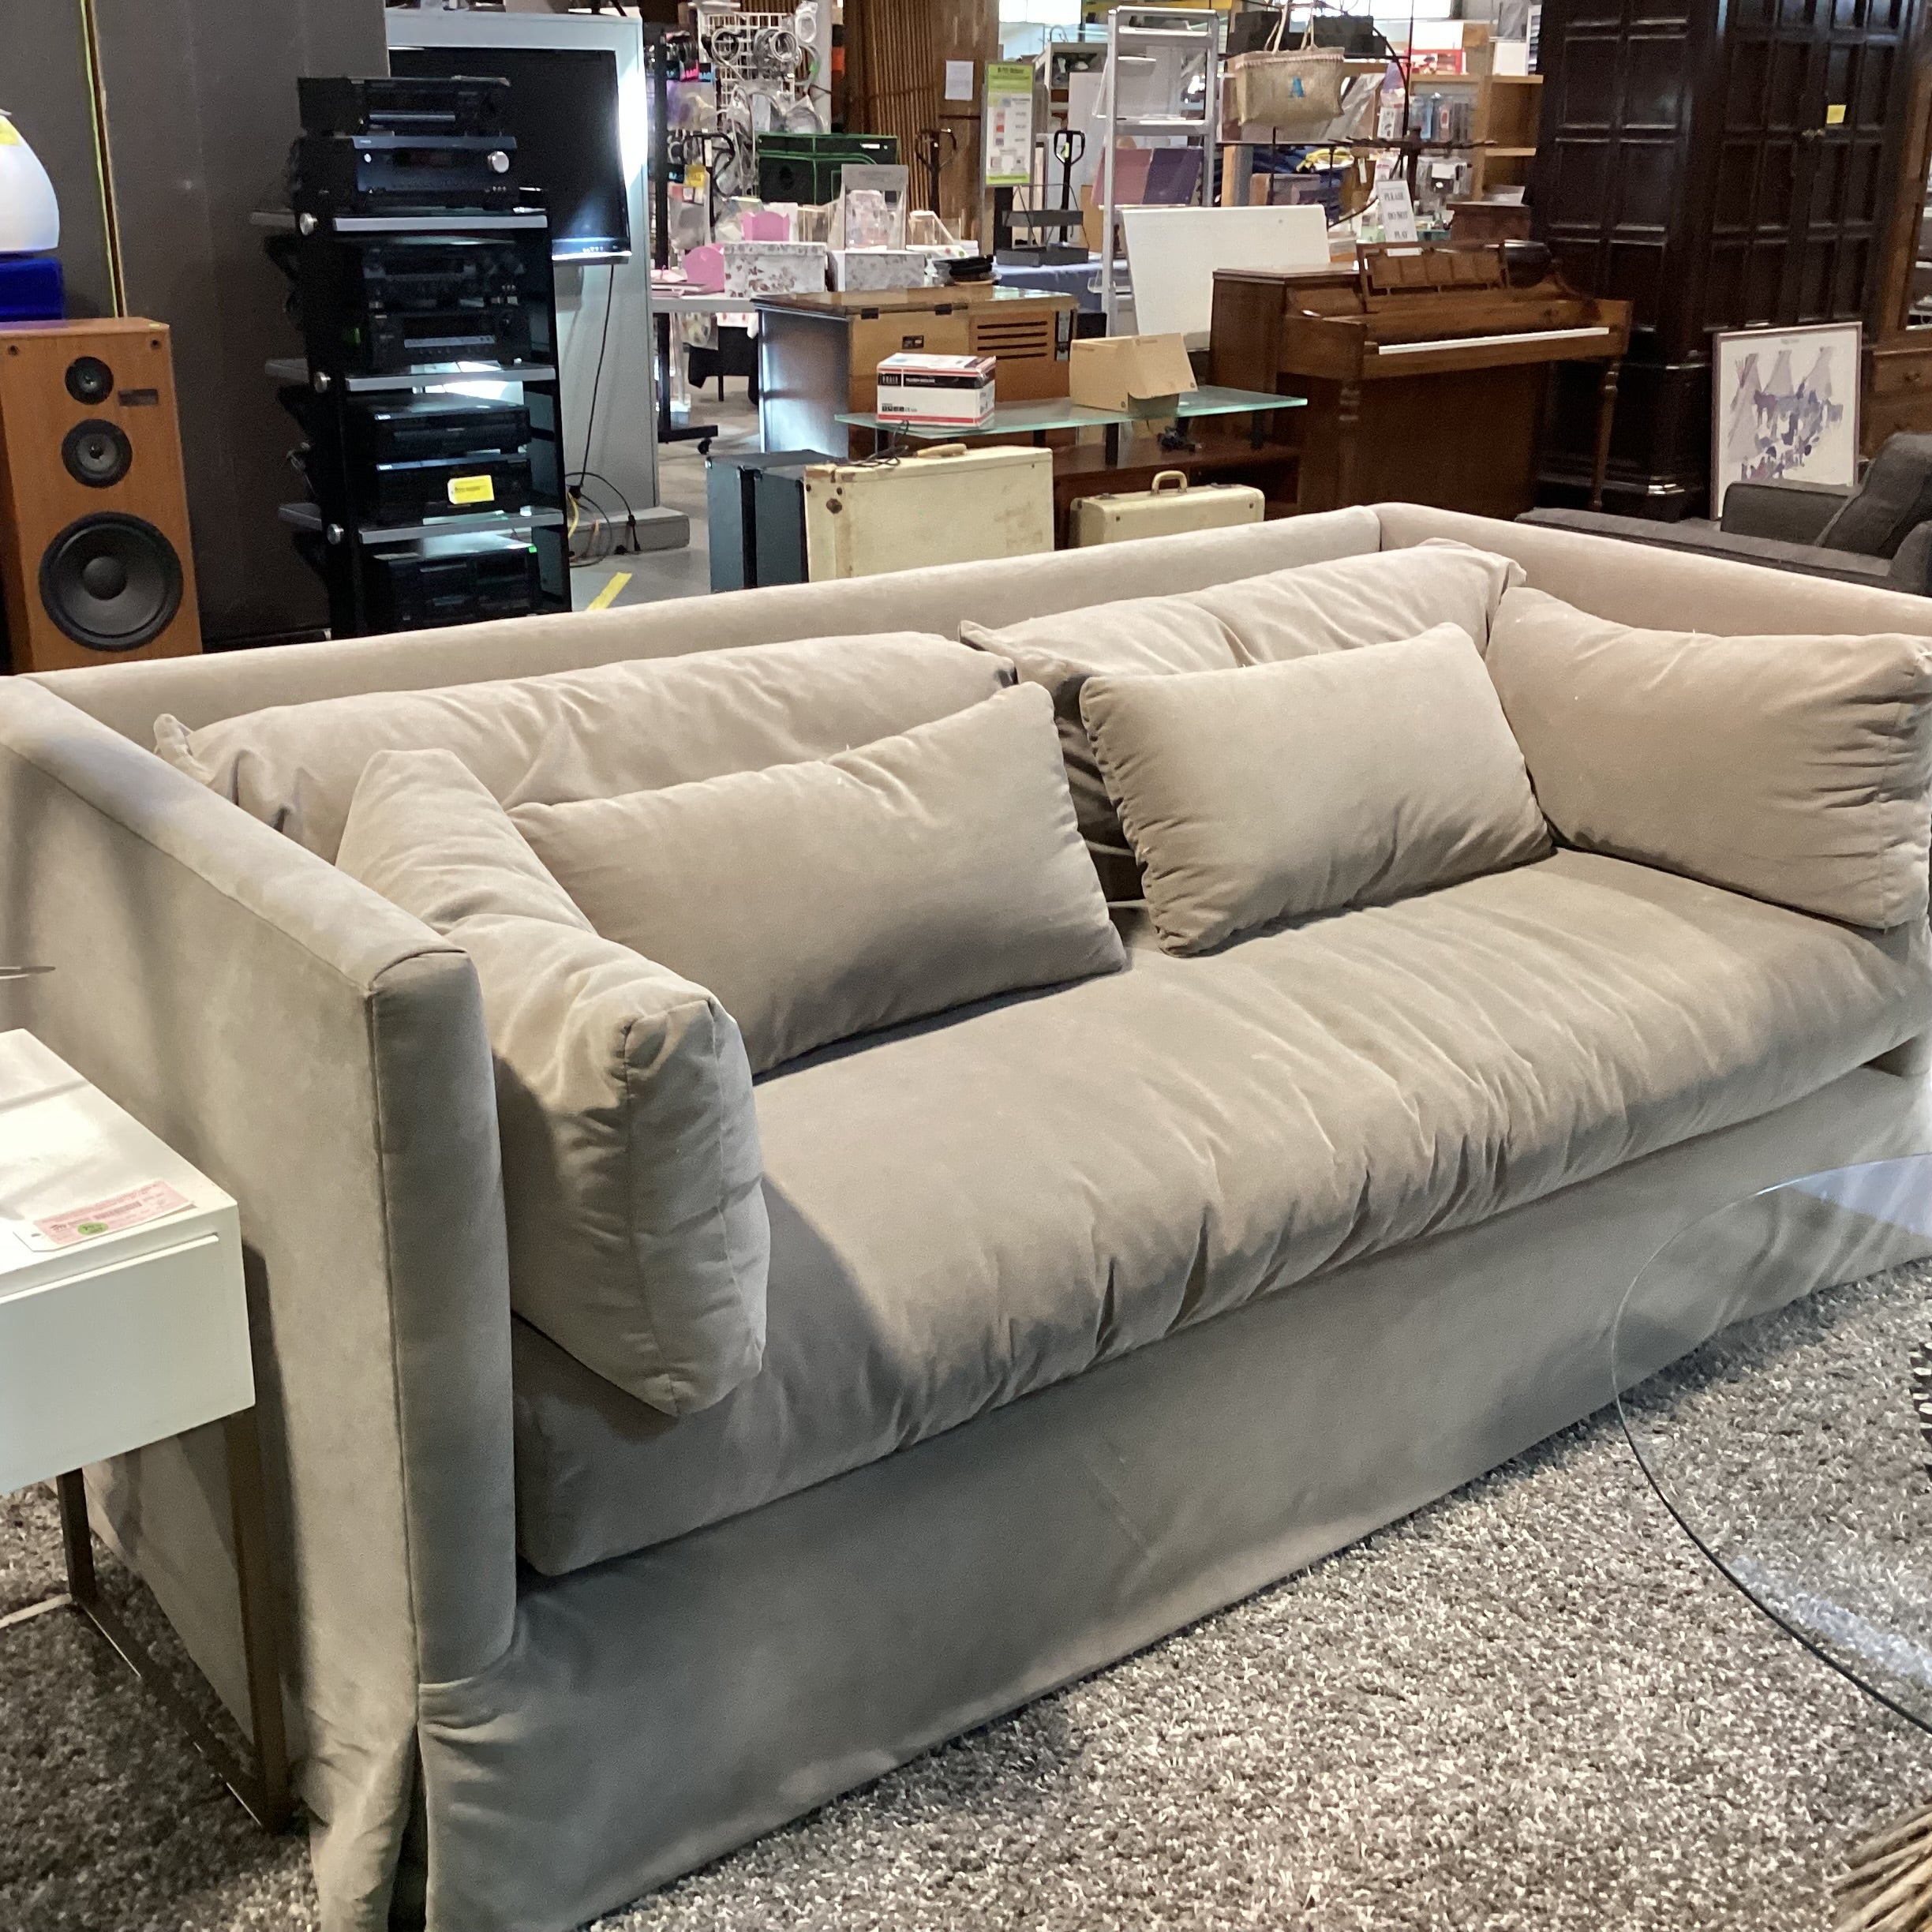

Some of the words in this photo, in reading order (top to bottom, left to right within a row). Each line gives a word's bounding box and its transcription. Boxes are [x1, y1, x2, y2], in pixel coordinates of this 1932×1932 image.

[1384, 192, 1404, 201] PLEASE
[1387, 212, 1396, 220] DO
[1397, 211, 1408, 219] NOT
[1394, 230, 1408, 239] PLAY
